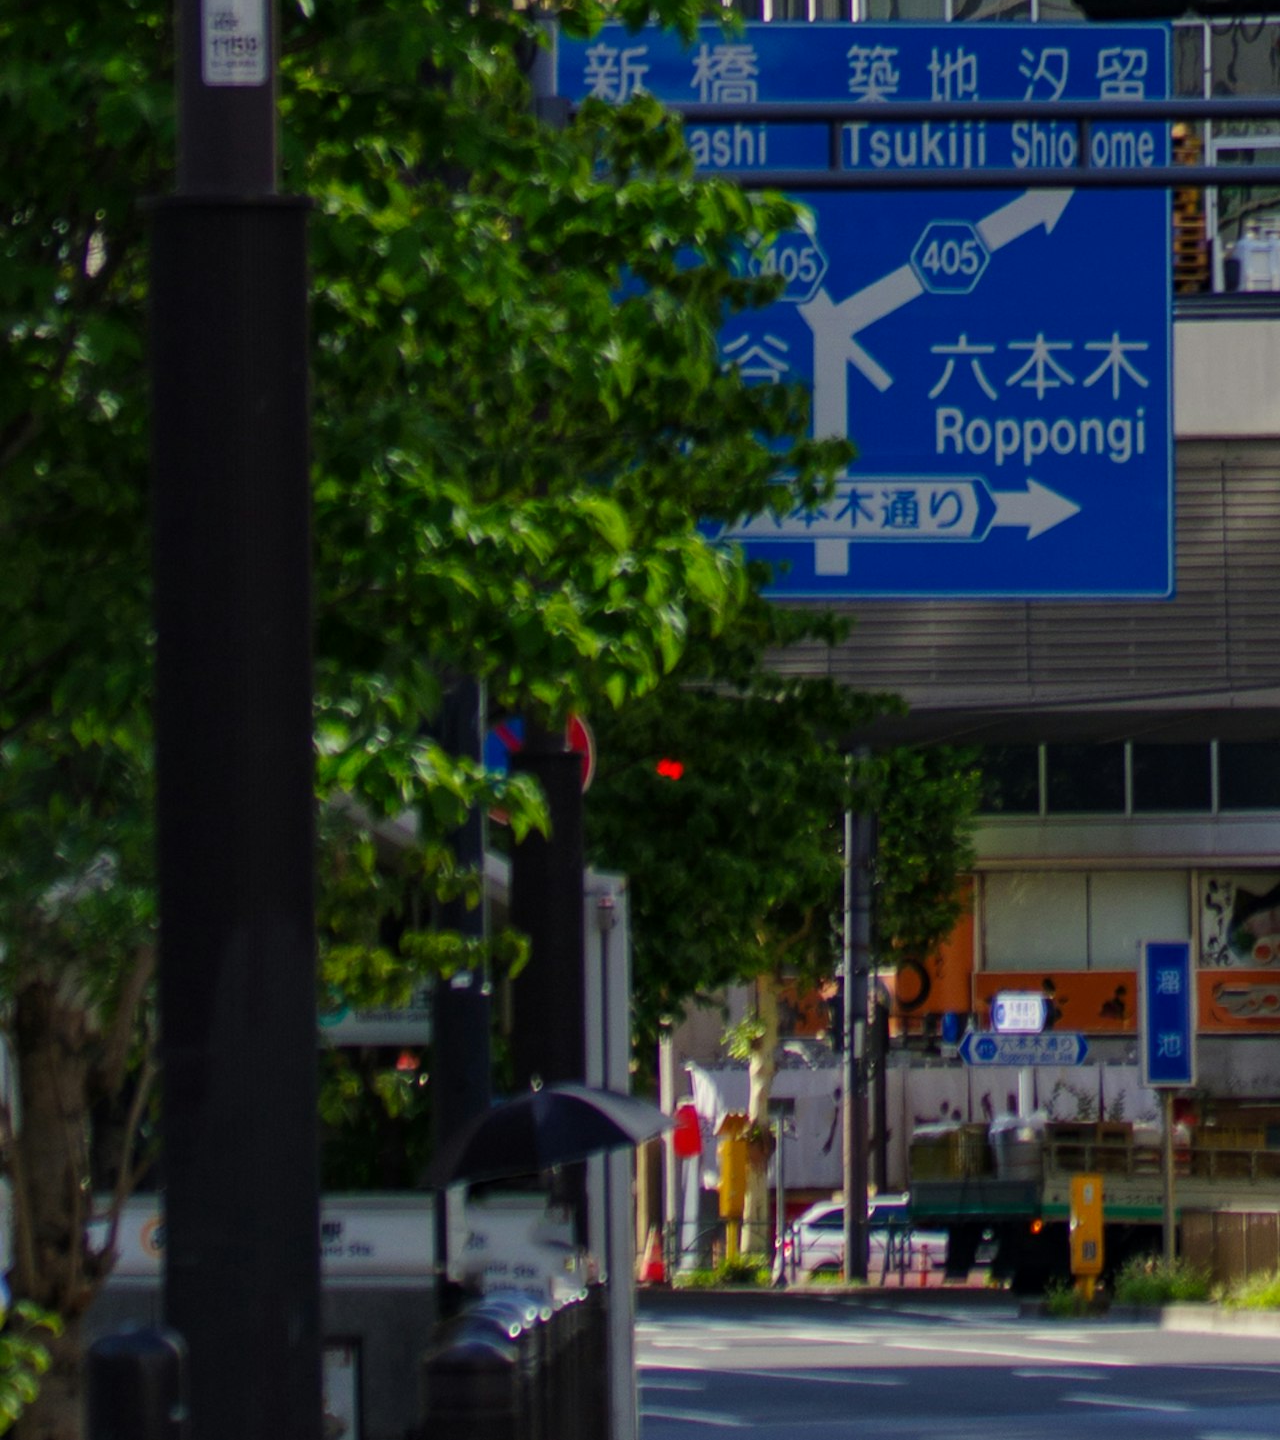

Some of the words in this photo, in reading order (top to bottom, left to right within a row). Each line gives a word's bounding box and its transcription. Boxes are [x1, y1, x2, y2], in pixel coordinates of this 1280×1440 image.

[845, 45, 979, 103] 築地
[1018, 46, 1148, 102] 汐留
[841, 122, 987, 169] Tsukiji
[1011, 121, 1154, 169] Shioome
[760, 246, 818, 284] 405
[922, 239, 980, 276] 405
[928, 332, 1150, 400] 六本木
[934, 407, 1146, 465] Roppongi
[1156, 969, 1182, 1057] 溜池
